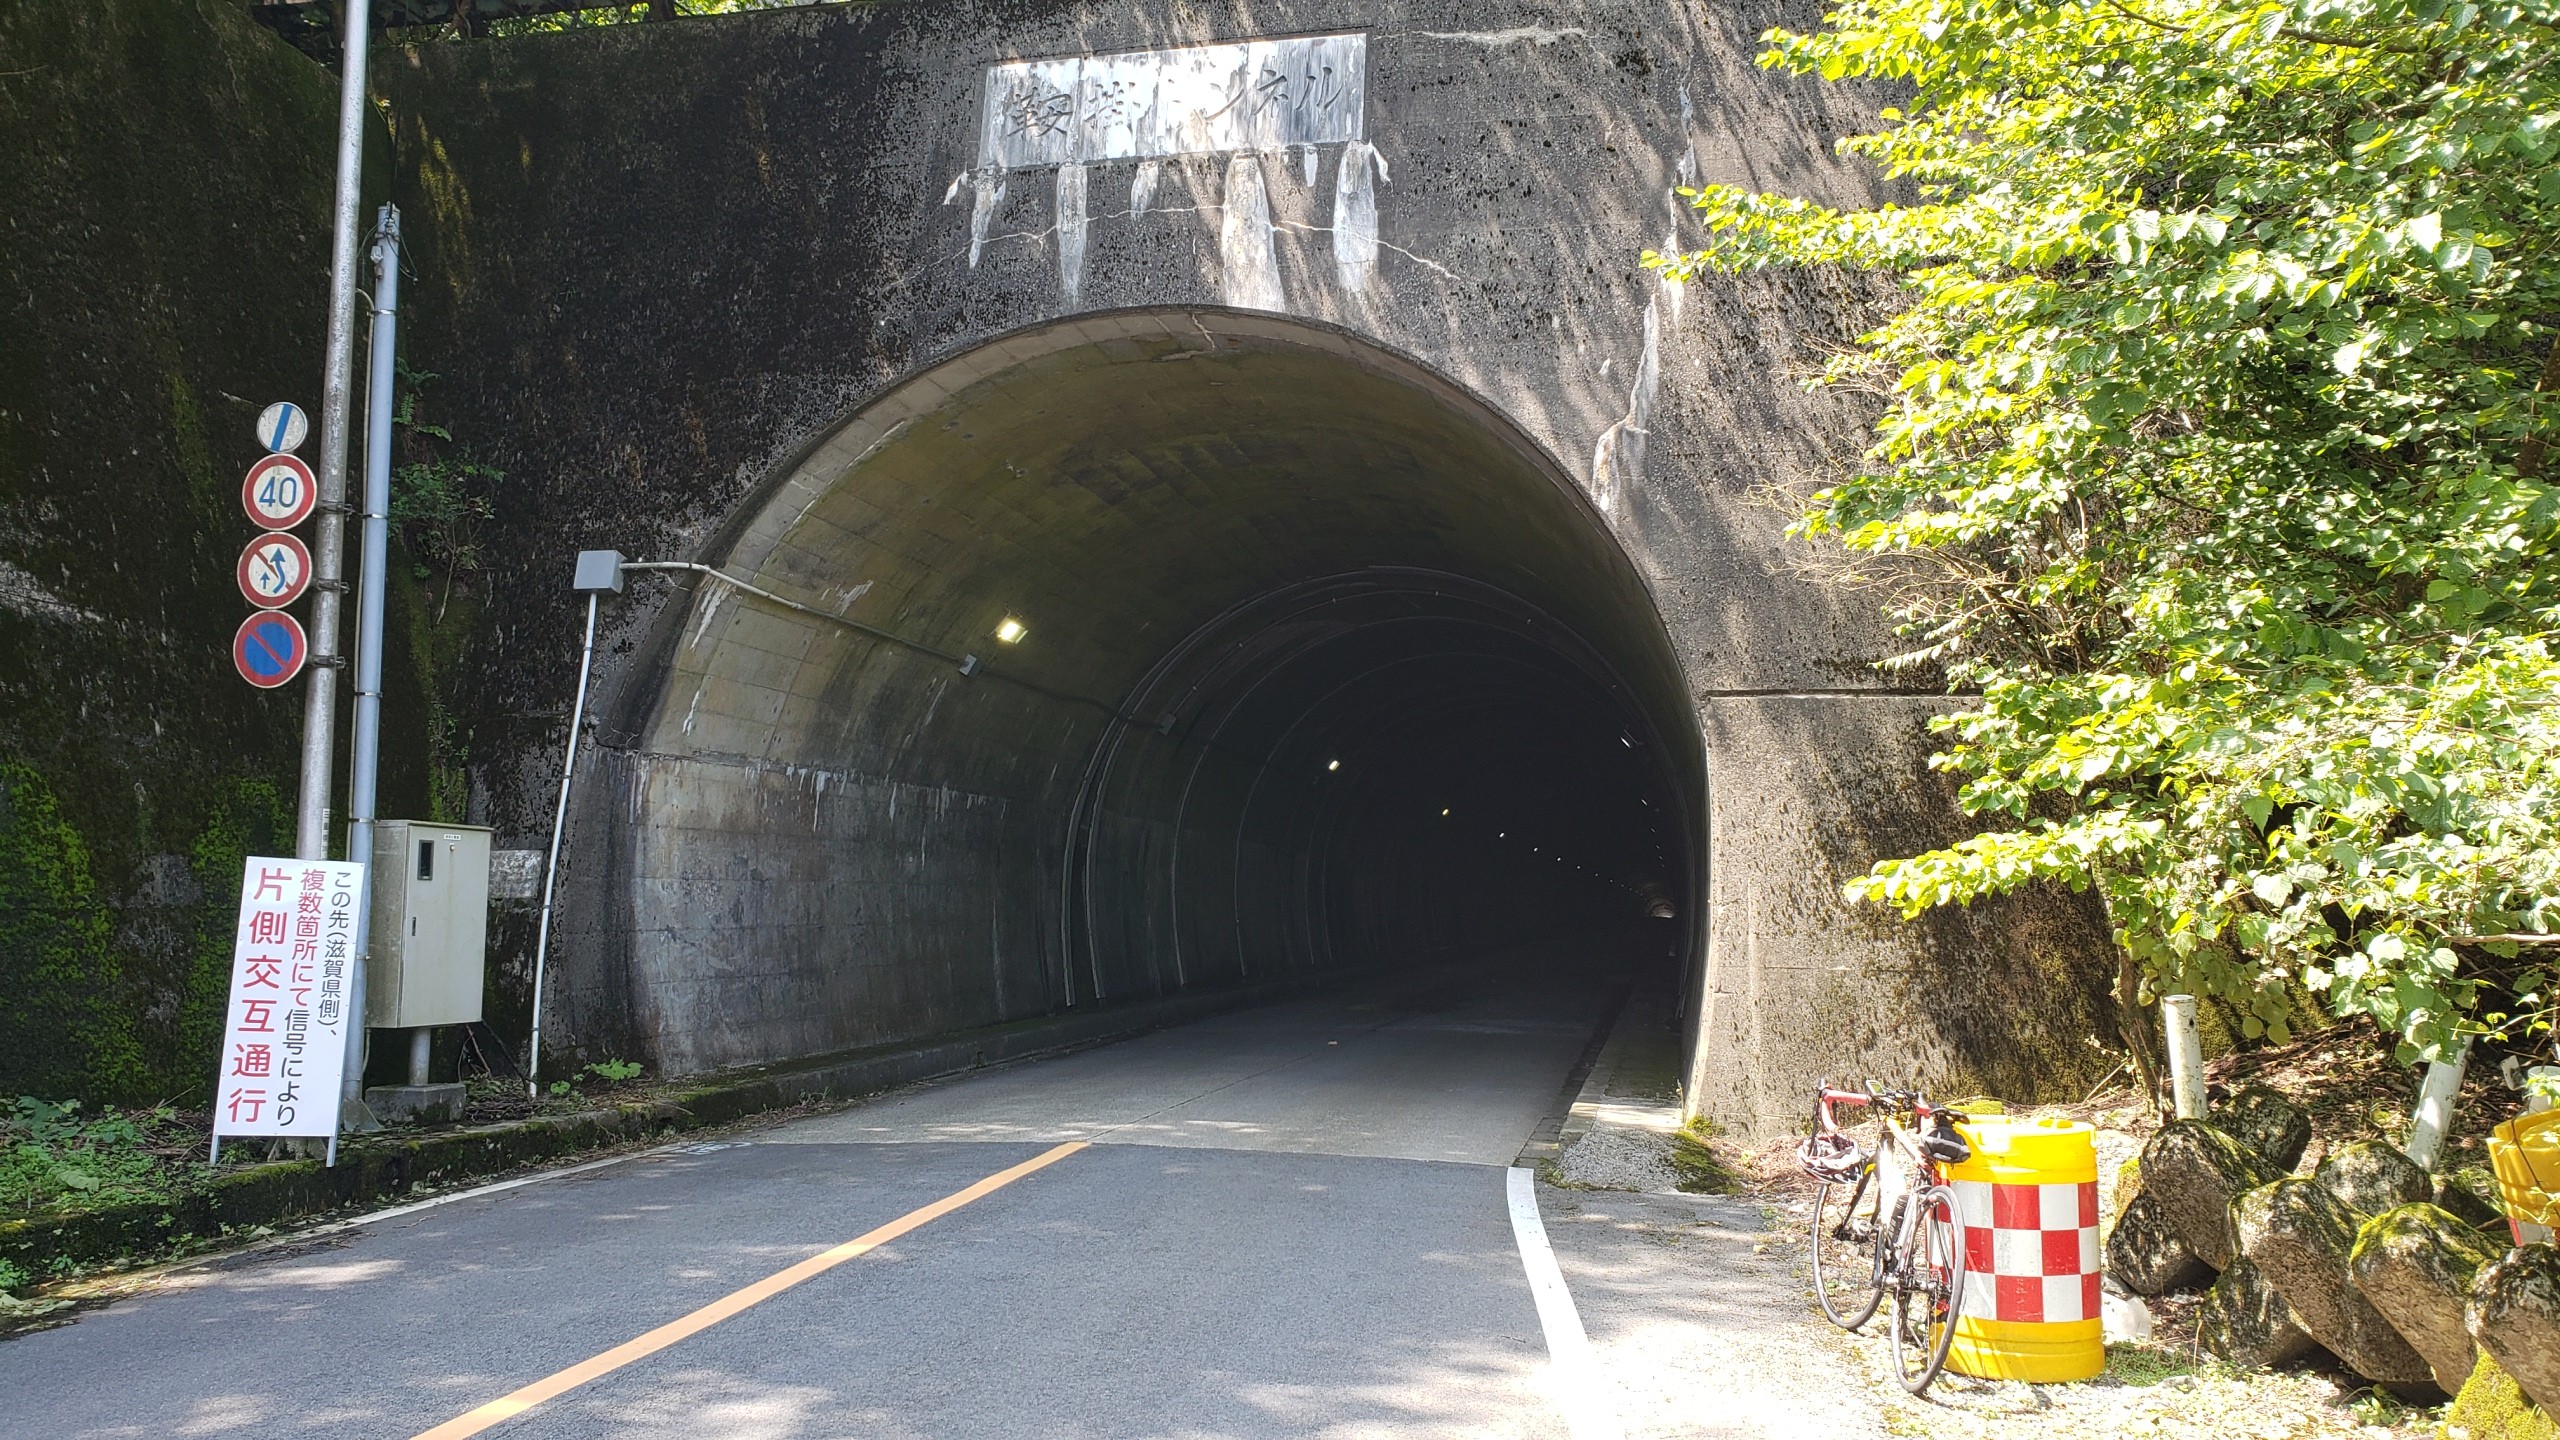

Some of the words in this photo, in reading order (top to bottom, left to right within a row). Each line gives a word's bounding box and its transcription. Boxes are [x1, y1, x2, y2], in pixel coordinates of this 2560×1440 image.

[260, 476, 297, 508] 40
[227, 867, 292, 1123] 片側交互通行
[277, 868, 327, 1127] 複数箇所にて信号により
